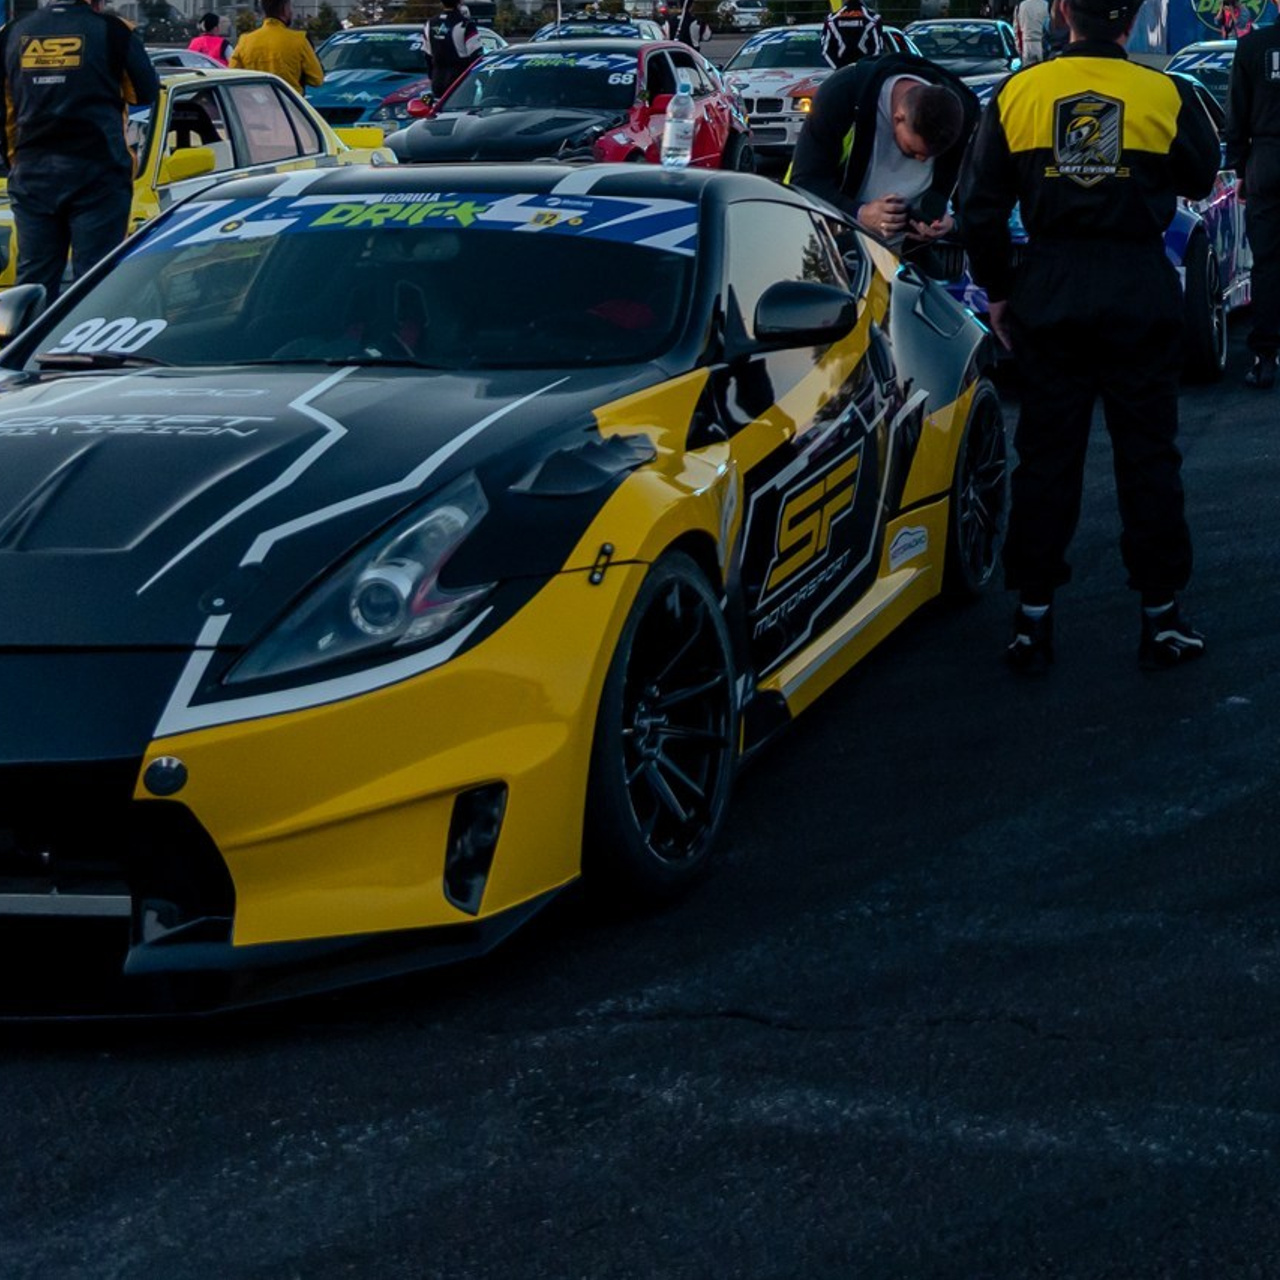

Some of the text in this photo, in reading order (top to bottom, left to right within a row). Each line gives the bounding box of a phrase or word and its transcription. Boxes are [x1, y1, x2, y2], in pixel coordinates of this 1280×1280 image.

[608, 73, 635, 85] 68
[383, 192, 440, 203] GORILLA
[47, 317, 168, 354] 900
[753, 548, 851, 640] MOTORSPORT
